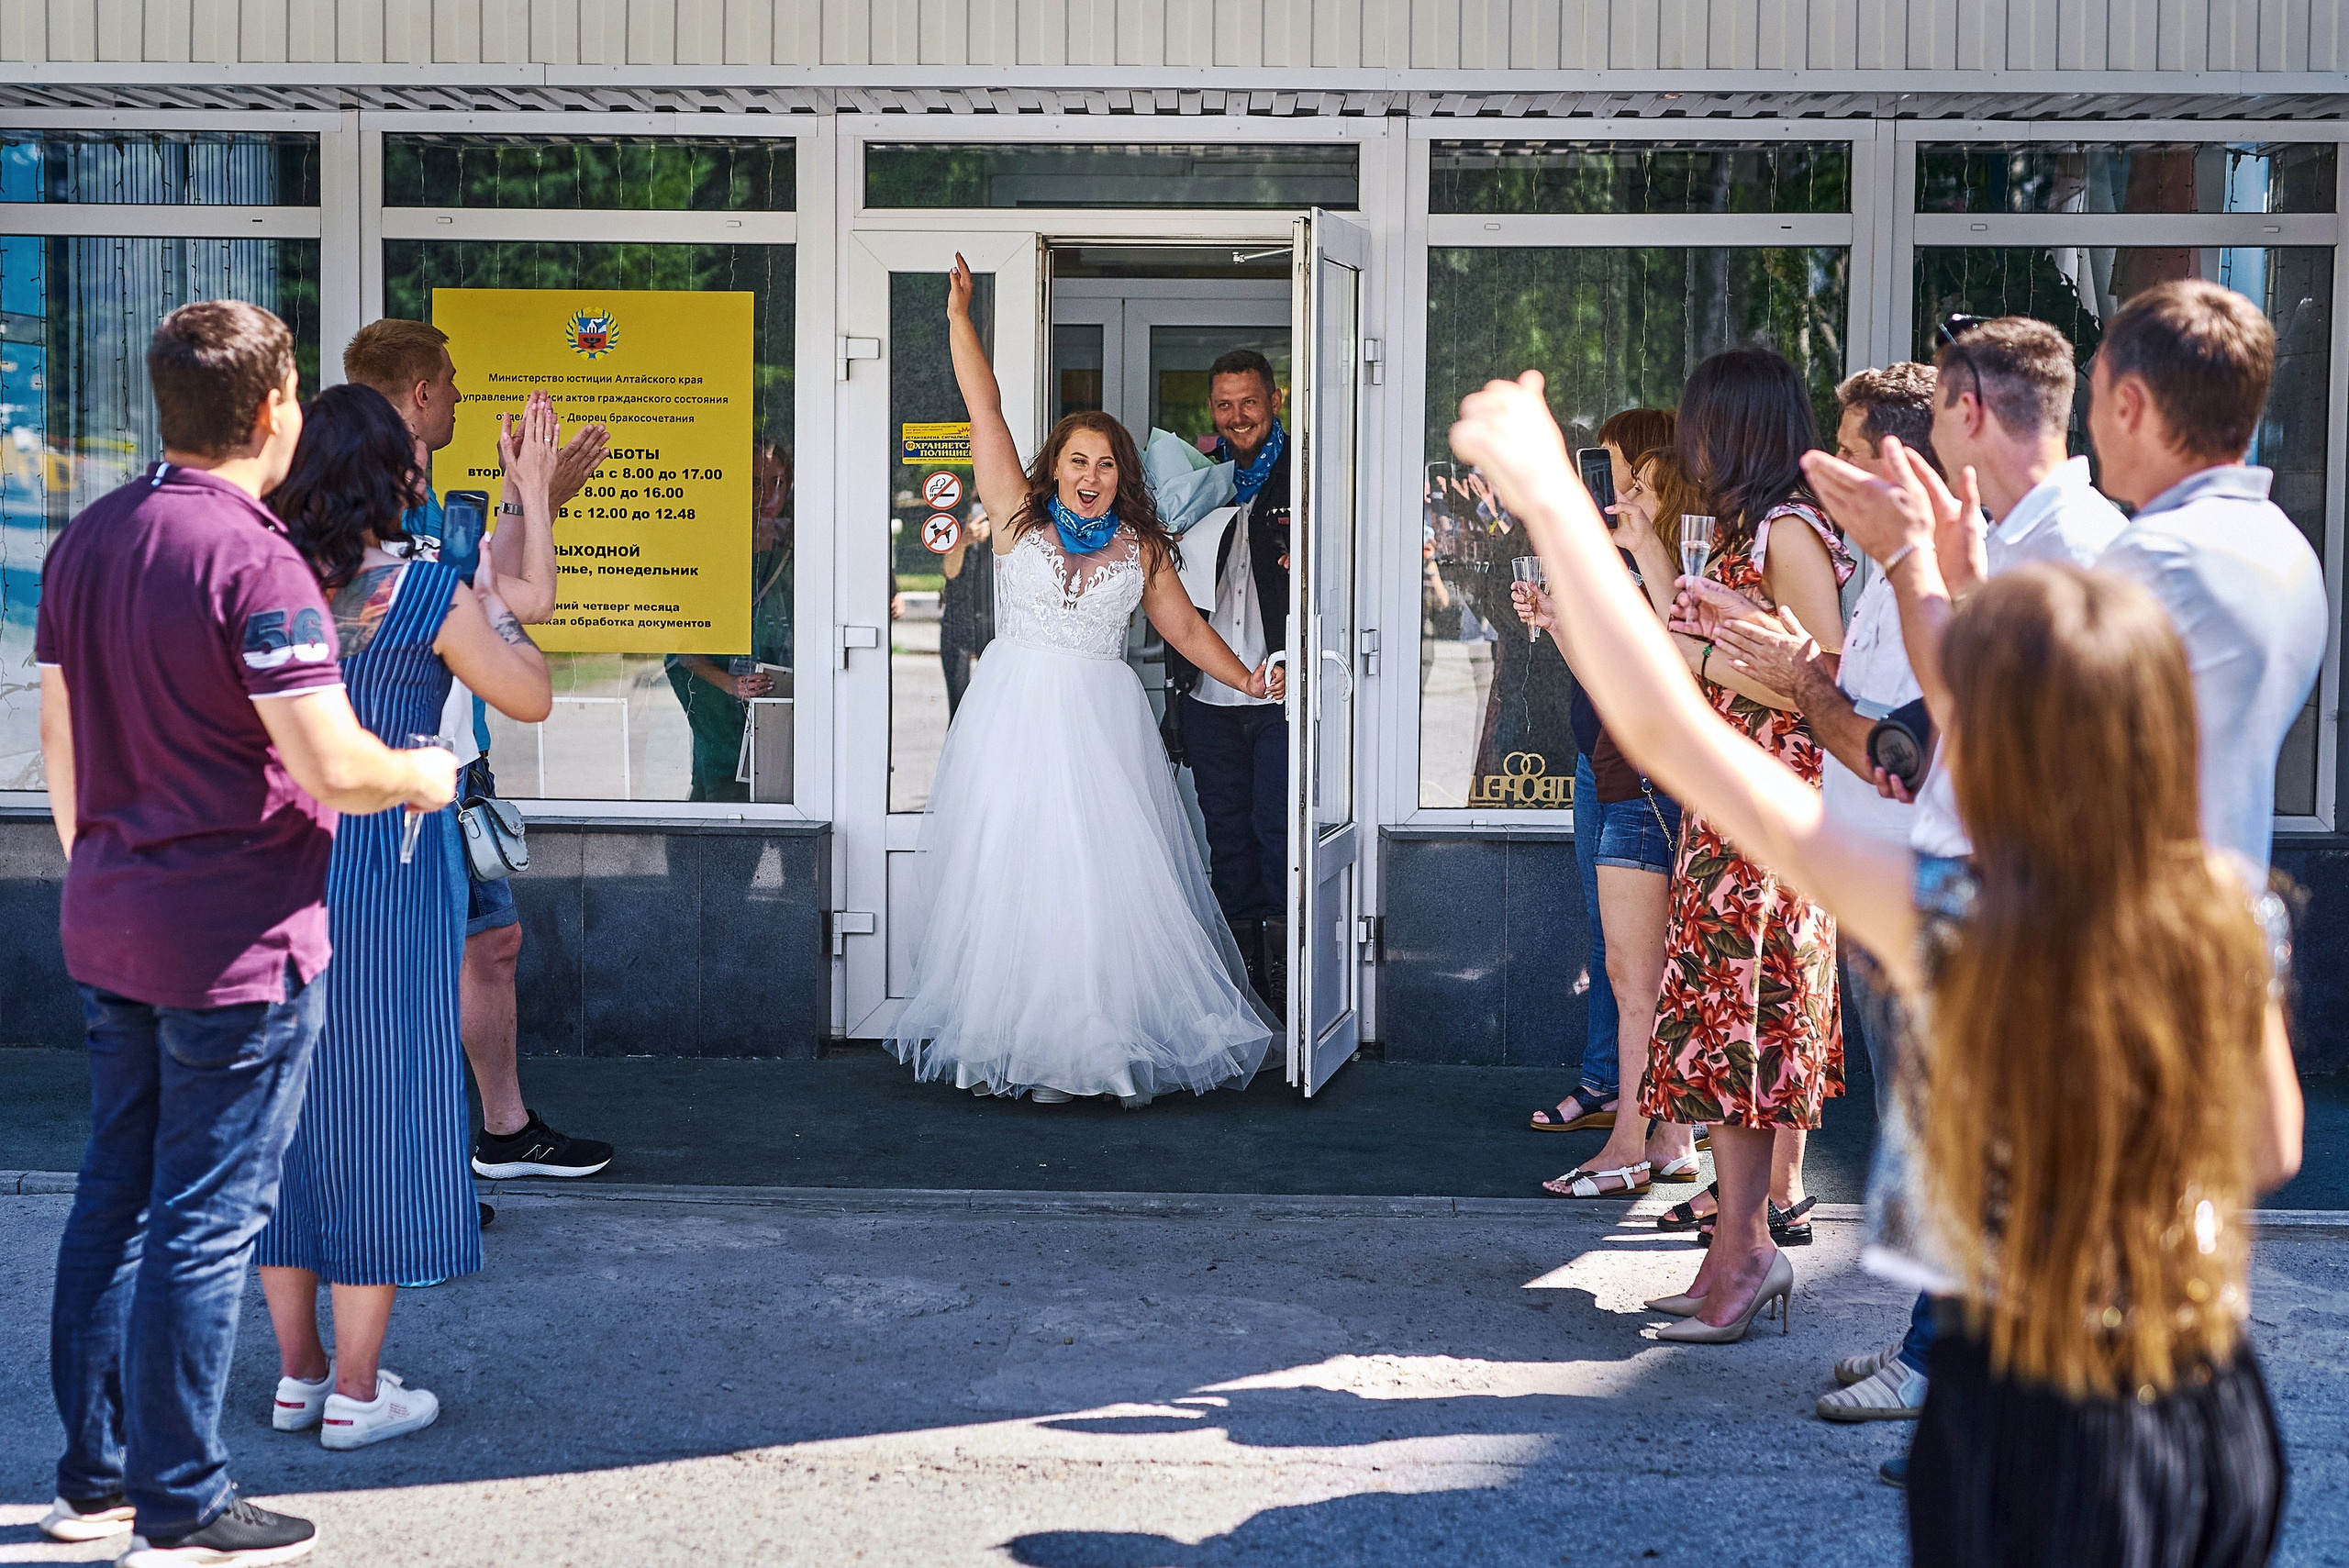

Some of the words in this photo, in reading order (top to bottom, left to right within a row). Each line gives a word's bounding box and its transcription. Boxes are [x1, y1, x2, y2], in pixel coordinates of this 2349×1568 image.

[488, 373, 564, 384] Министерство
[566, 374, 612, 384] юстиции
[615, 374, 676, 384] Алтайского
[678, 376, 703, 385] края
[462, 393, 525, 404] управление
[597, 395, 672, 405] гражданского
[674, 396, 729, 405] состояния
[566, 412, 607, 423] Дворец
[609, 412, 695, 424] бракосочетания
[622, 467, 654, 479] 8.00
[658, 470, 677, 482] до
[682, 468, 723, 480] 17.00
[584, 486, 616, 498] 8.00
[619, 489, 639, 500] до
[643, 487, 684, 498] 16.00
[587, 507, 628, 519] 12.00
[631, 510, 651, 521] до
[655, 508, 696, 520] 12.48
[597, 565, 699, 577] понедельник
[583, 603, 630, 613] четверг
[634, 604, 680, 613] месяца
[570, 617, 634, 628] обработка
[638, 619, 711, 628] документов
[241, 607, 330, 670] 56
